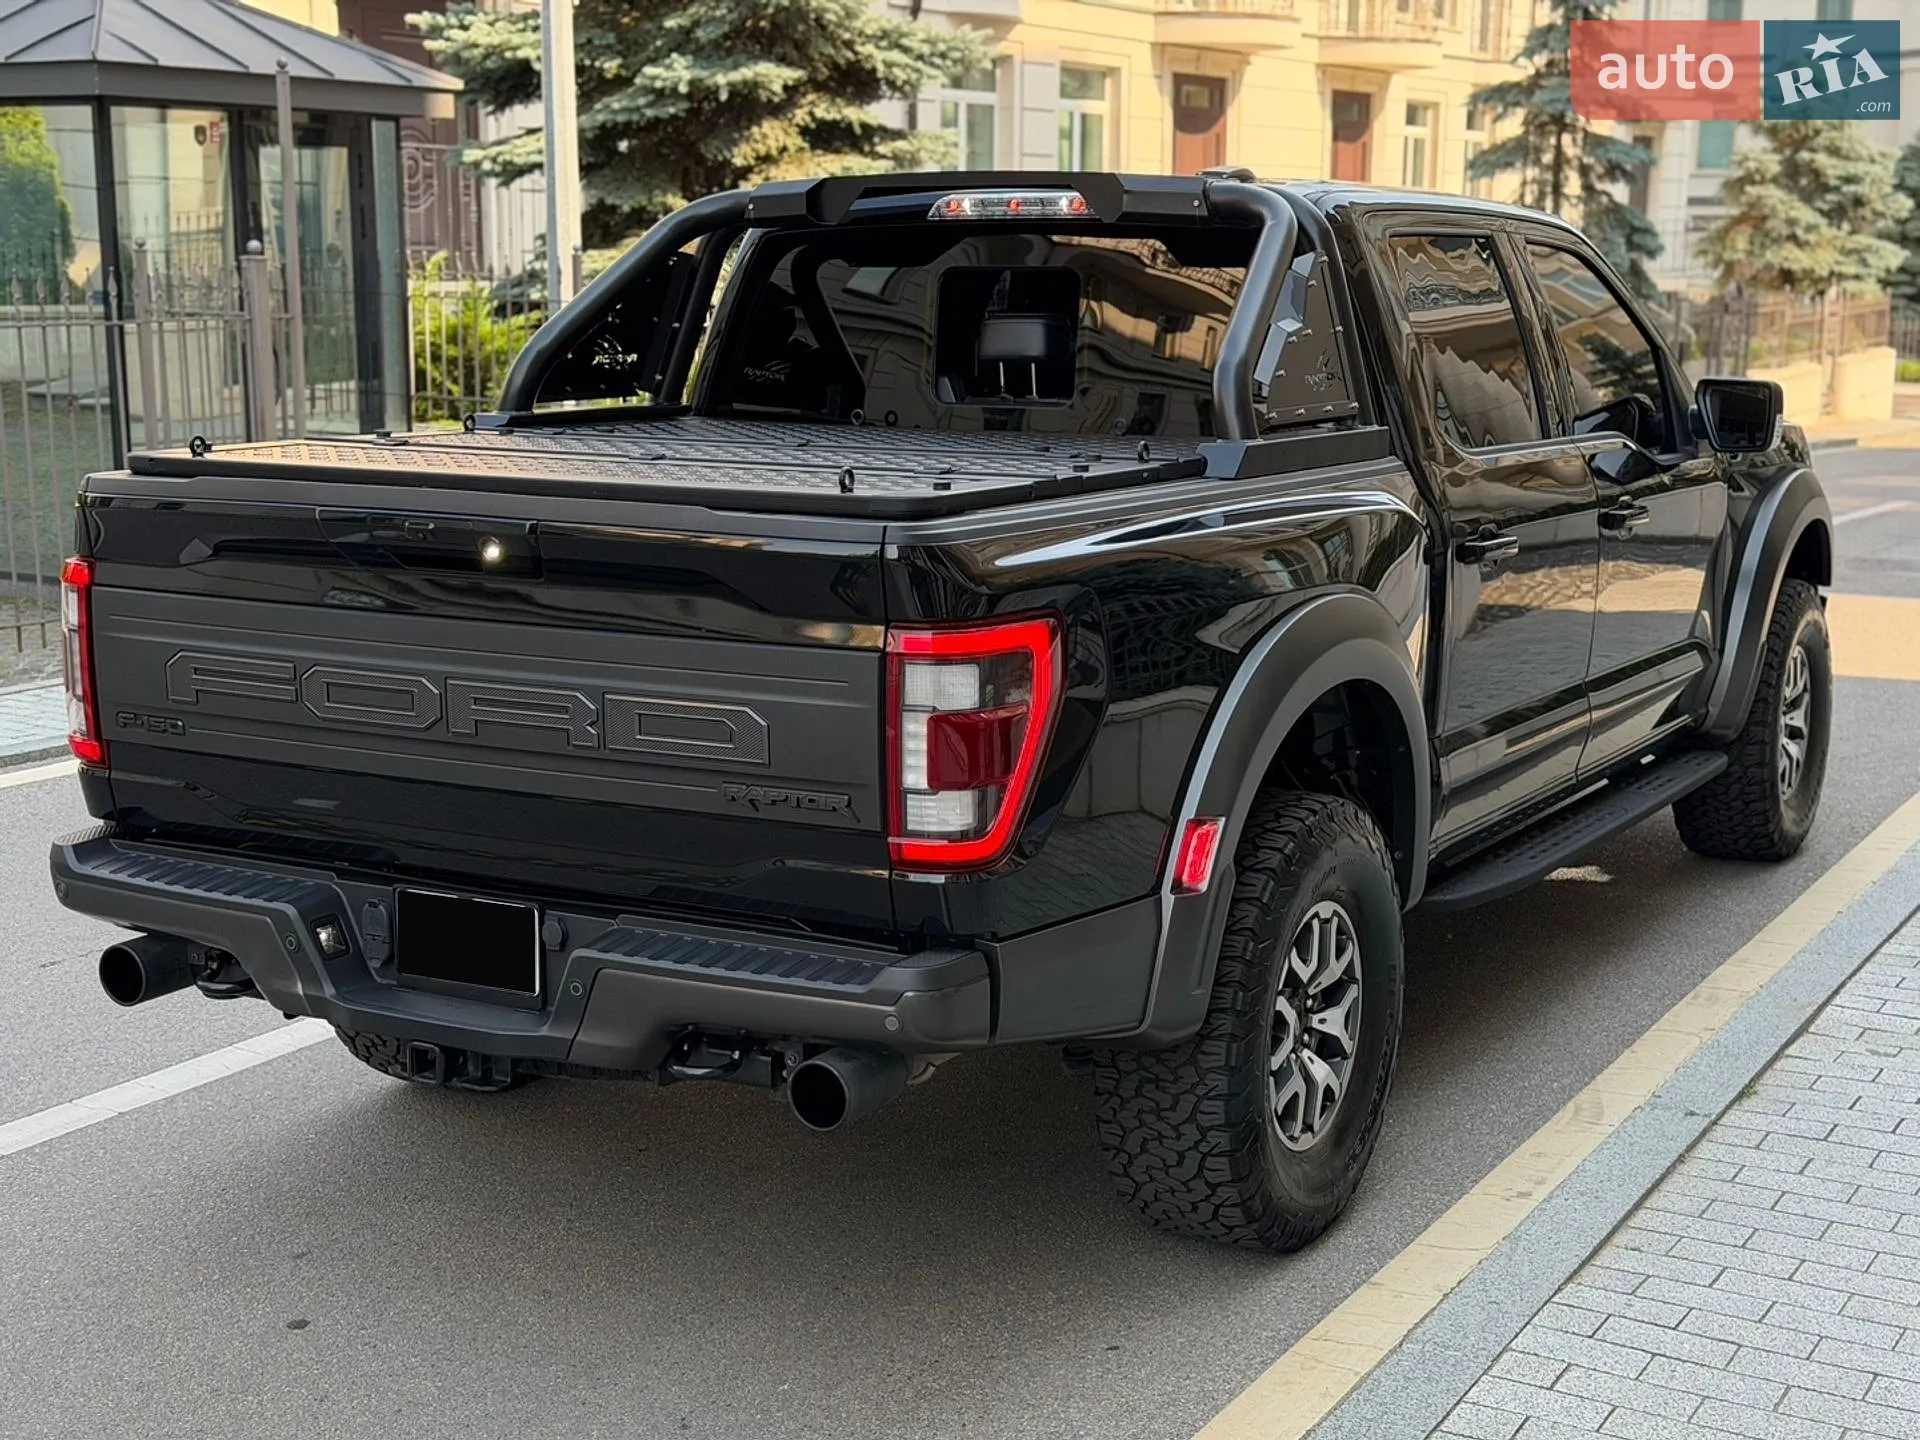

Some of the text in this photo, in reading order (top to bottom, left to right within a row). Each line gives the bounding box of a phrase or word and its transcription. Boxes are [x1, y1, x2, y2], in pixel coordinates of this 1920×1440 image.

[115, 711, 186, 736] F-150
[165, 650, 771, 767] FORD
[721, 781, 861, 823] RAPTOR
